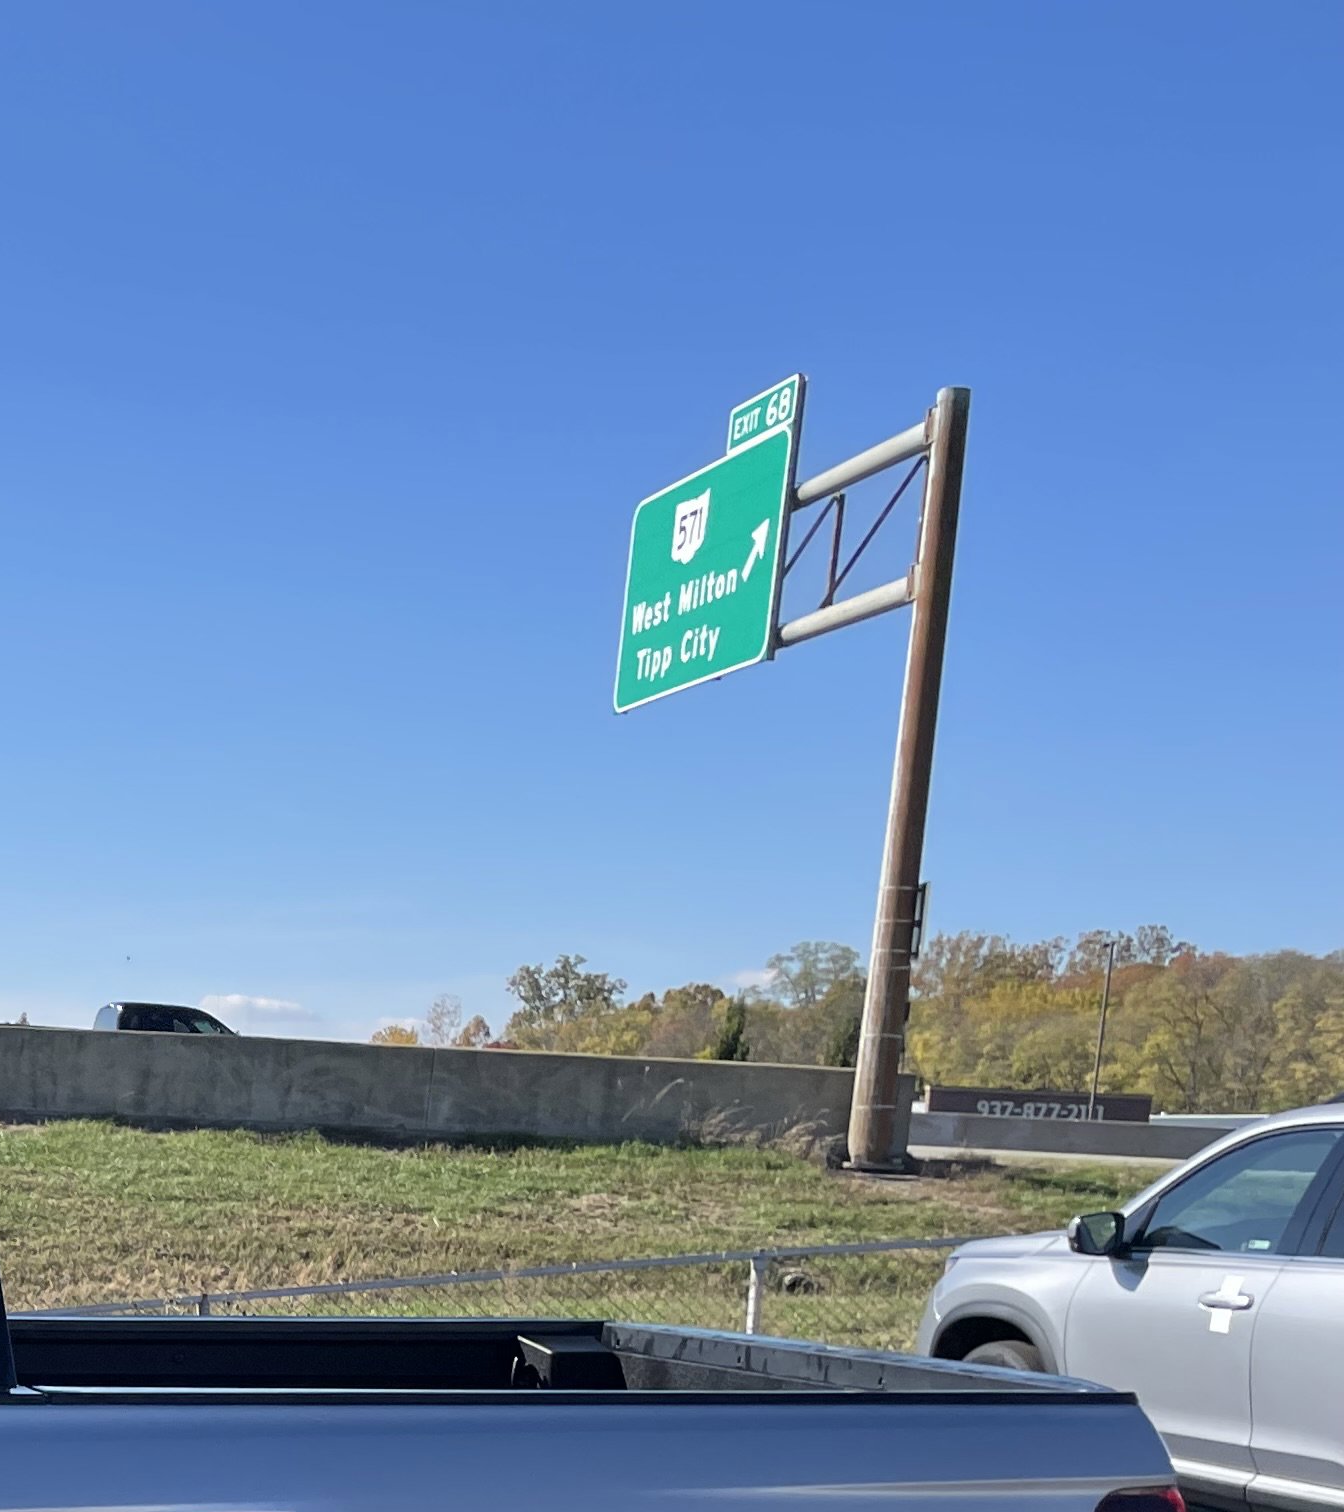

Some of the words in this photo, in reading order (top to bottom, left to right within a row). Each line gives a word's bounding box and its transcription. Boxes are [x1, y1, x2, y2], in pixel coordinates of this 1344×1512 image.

[733, 407, 760, 440] EXIT
[765, 388, 791, 427] 68
[677, 509, 703, 549] 571
[631, 592, 671, 635] West
[678, 568, 737, 615] Milton
[636, 646, 672, 682] Tipp
[680, 625, 720, 661] City
[976, 1099, 1105, 1122] 937-877-211
